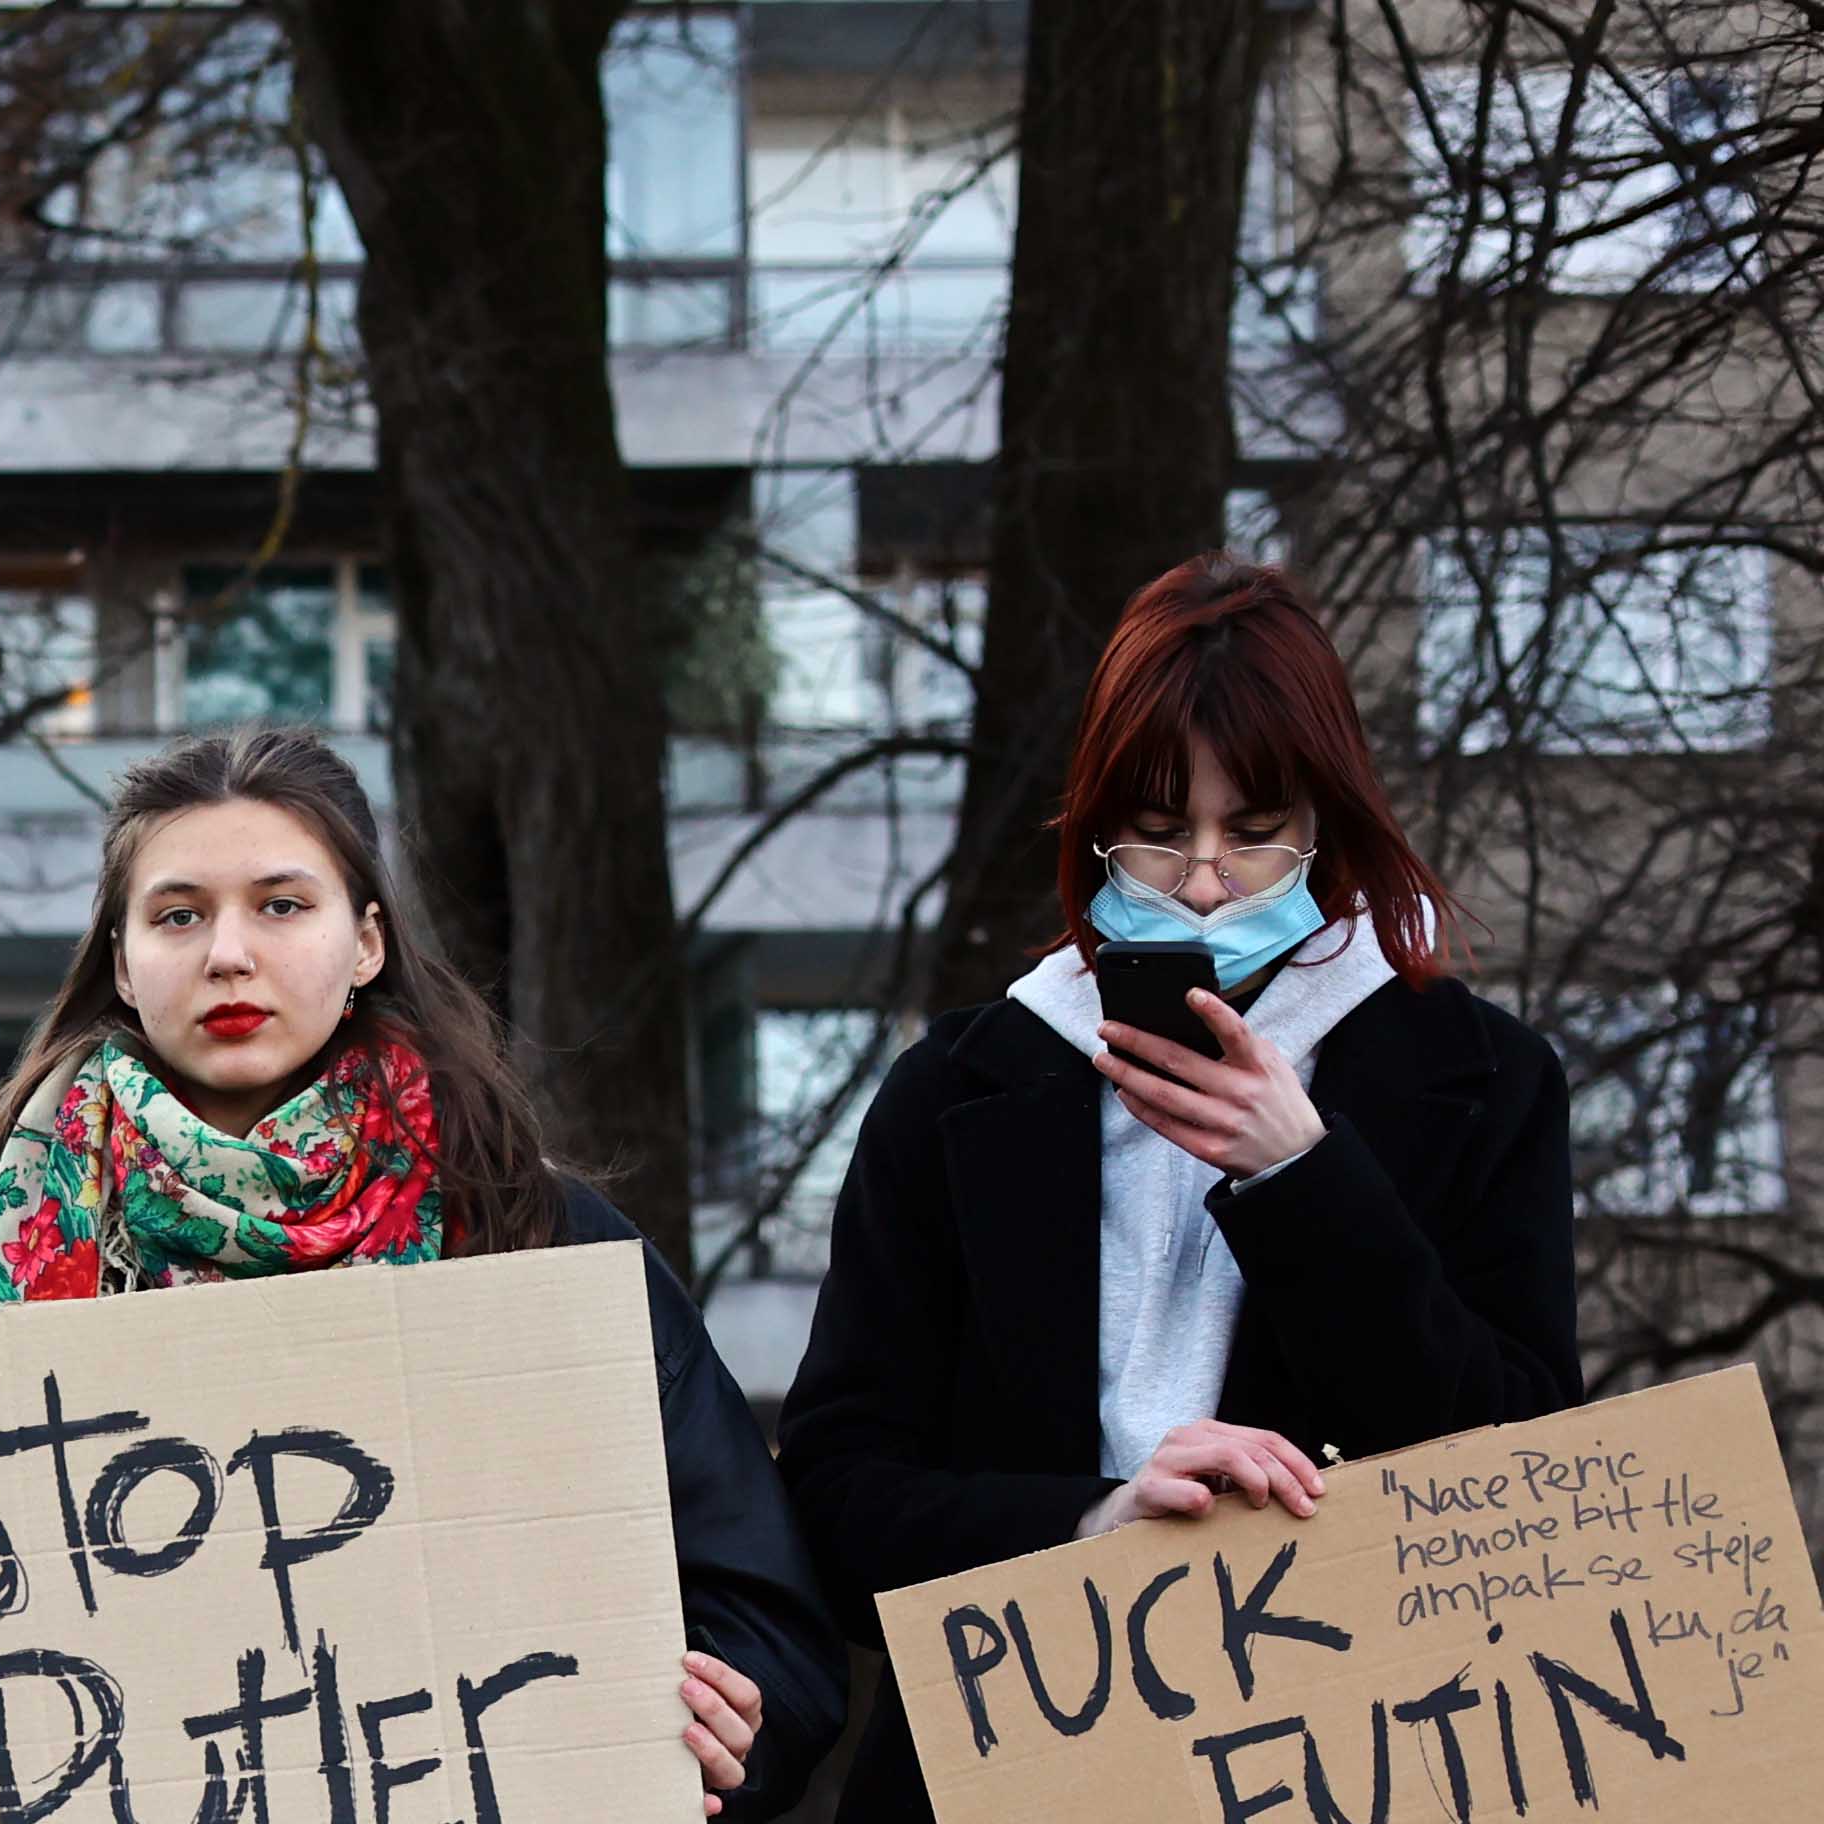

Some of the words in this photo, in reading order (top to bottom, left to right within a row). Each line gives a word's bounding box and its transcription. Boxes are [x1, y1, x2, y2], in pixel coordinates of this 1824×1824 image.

[1573, 1485, 1643, 1533] bit
[1652, 1472, 1724, 1527] tle
[1397, 1552, 1585, 1627] ampak
[944, 1540, 1352, 1758] PUCK
